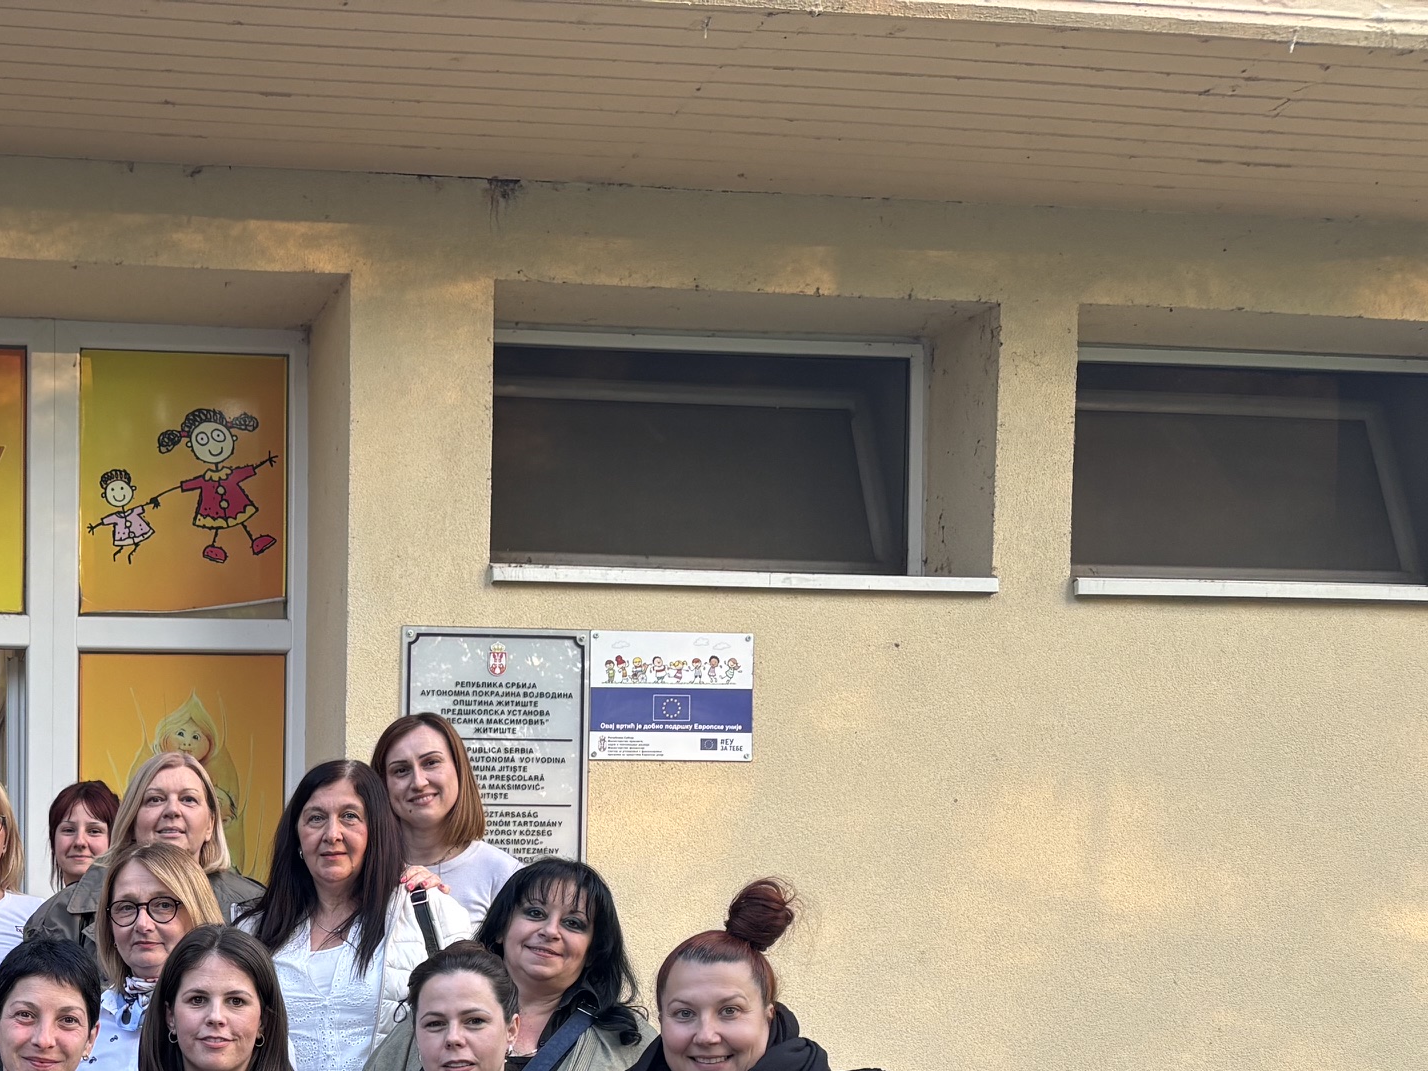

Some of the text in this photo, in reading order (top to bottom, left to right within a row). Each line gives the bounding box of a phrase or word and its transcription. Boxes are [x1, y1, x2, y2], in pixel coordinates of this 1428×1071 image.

[455, 680, 537, 690] РЕПУБЛИКА СРБИЈА
[420, 689, 573, 699] АУТОНОМНА ПОКРАЈИНА ВОЈВОДИНА
[452, 699, 539, 708] ОПШТИНА ЖИТИШТЕ
[440, 708, 550, 717] ПРЕДШКОЛСКА УСТАНОВА
[446, 717, 484, 725] ДЕСАНКА
[473, 726, 517, 735] ЖИТИШТЕ
[600, 722, 615, 731] Овај
[616, 723, 635, 731] вртић
[636, 723, 642, 731] је
[664, 723, 693, 731] подршку
[693, 723, 724, 731] Европске
[724, 724, 743, 732] уније
[504, 747, 534, 755] SERBIA
[484, 810, 539, 818] ÖZTÁRSASÁG
[511, 819, 563, 828] TARTOMÁNY
[483, 828, 553, 837] GYÖRGY KÖZSÉG
